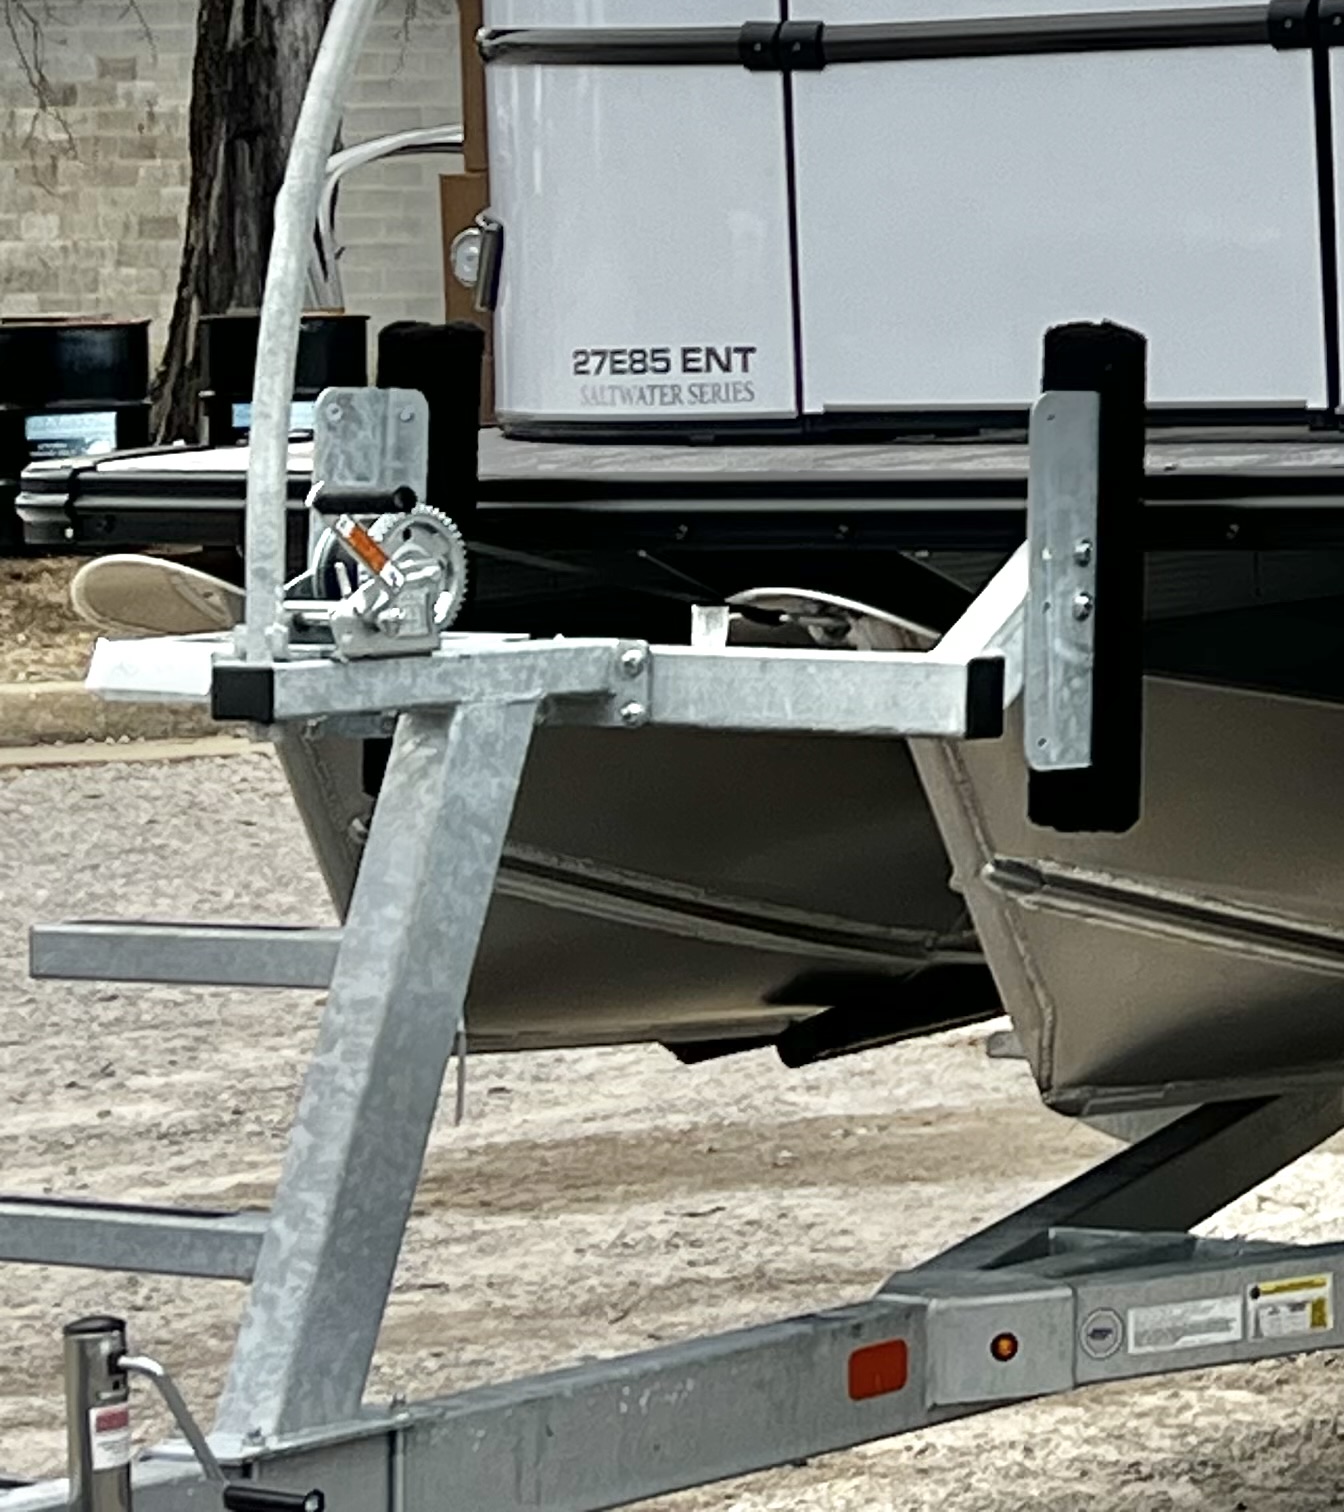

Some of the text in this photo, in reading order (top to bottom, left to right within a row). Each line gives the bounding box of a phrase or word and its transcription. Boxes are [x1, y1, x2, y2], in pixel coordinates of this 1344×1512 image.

[681, 346, 757, 374] ENT
[580, 380, 756, 406] SALTWATER SERIES
